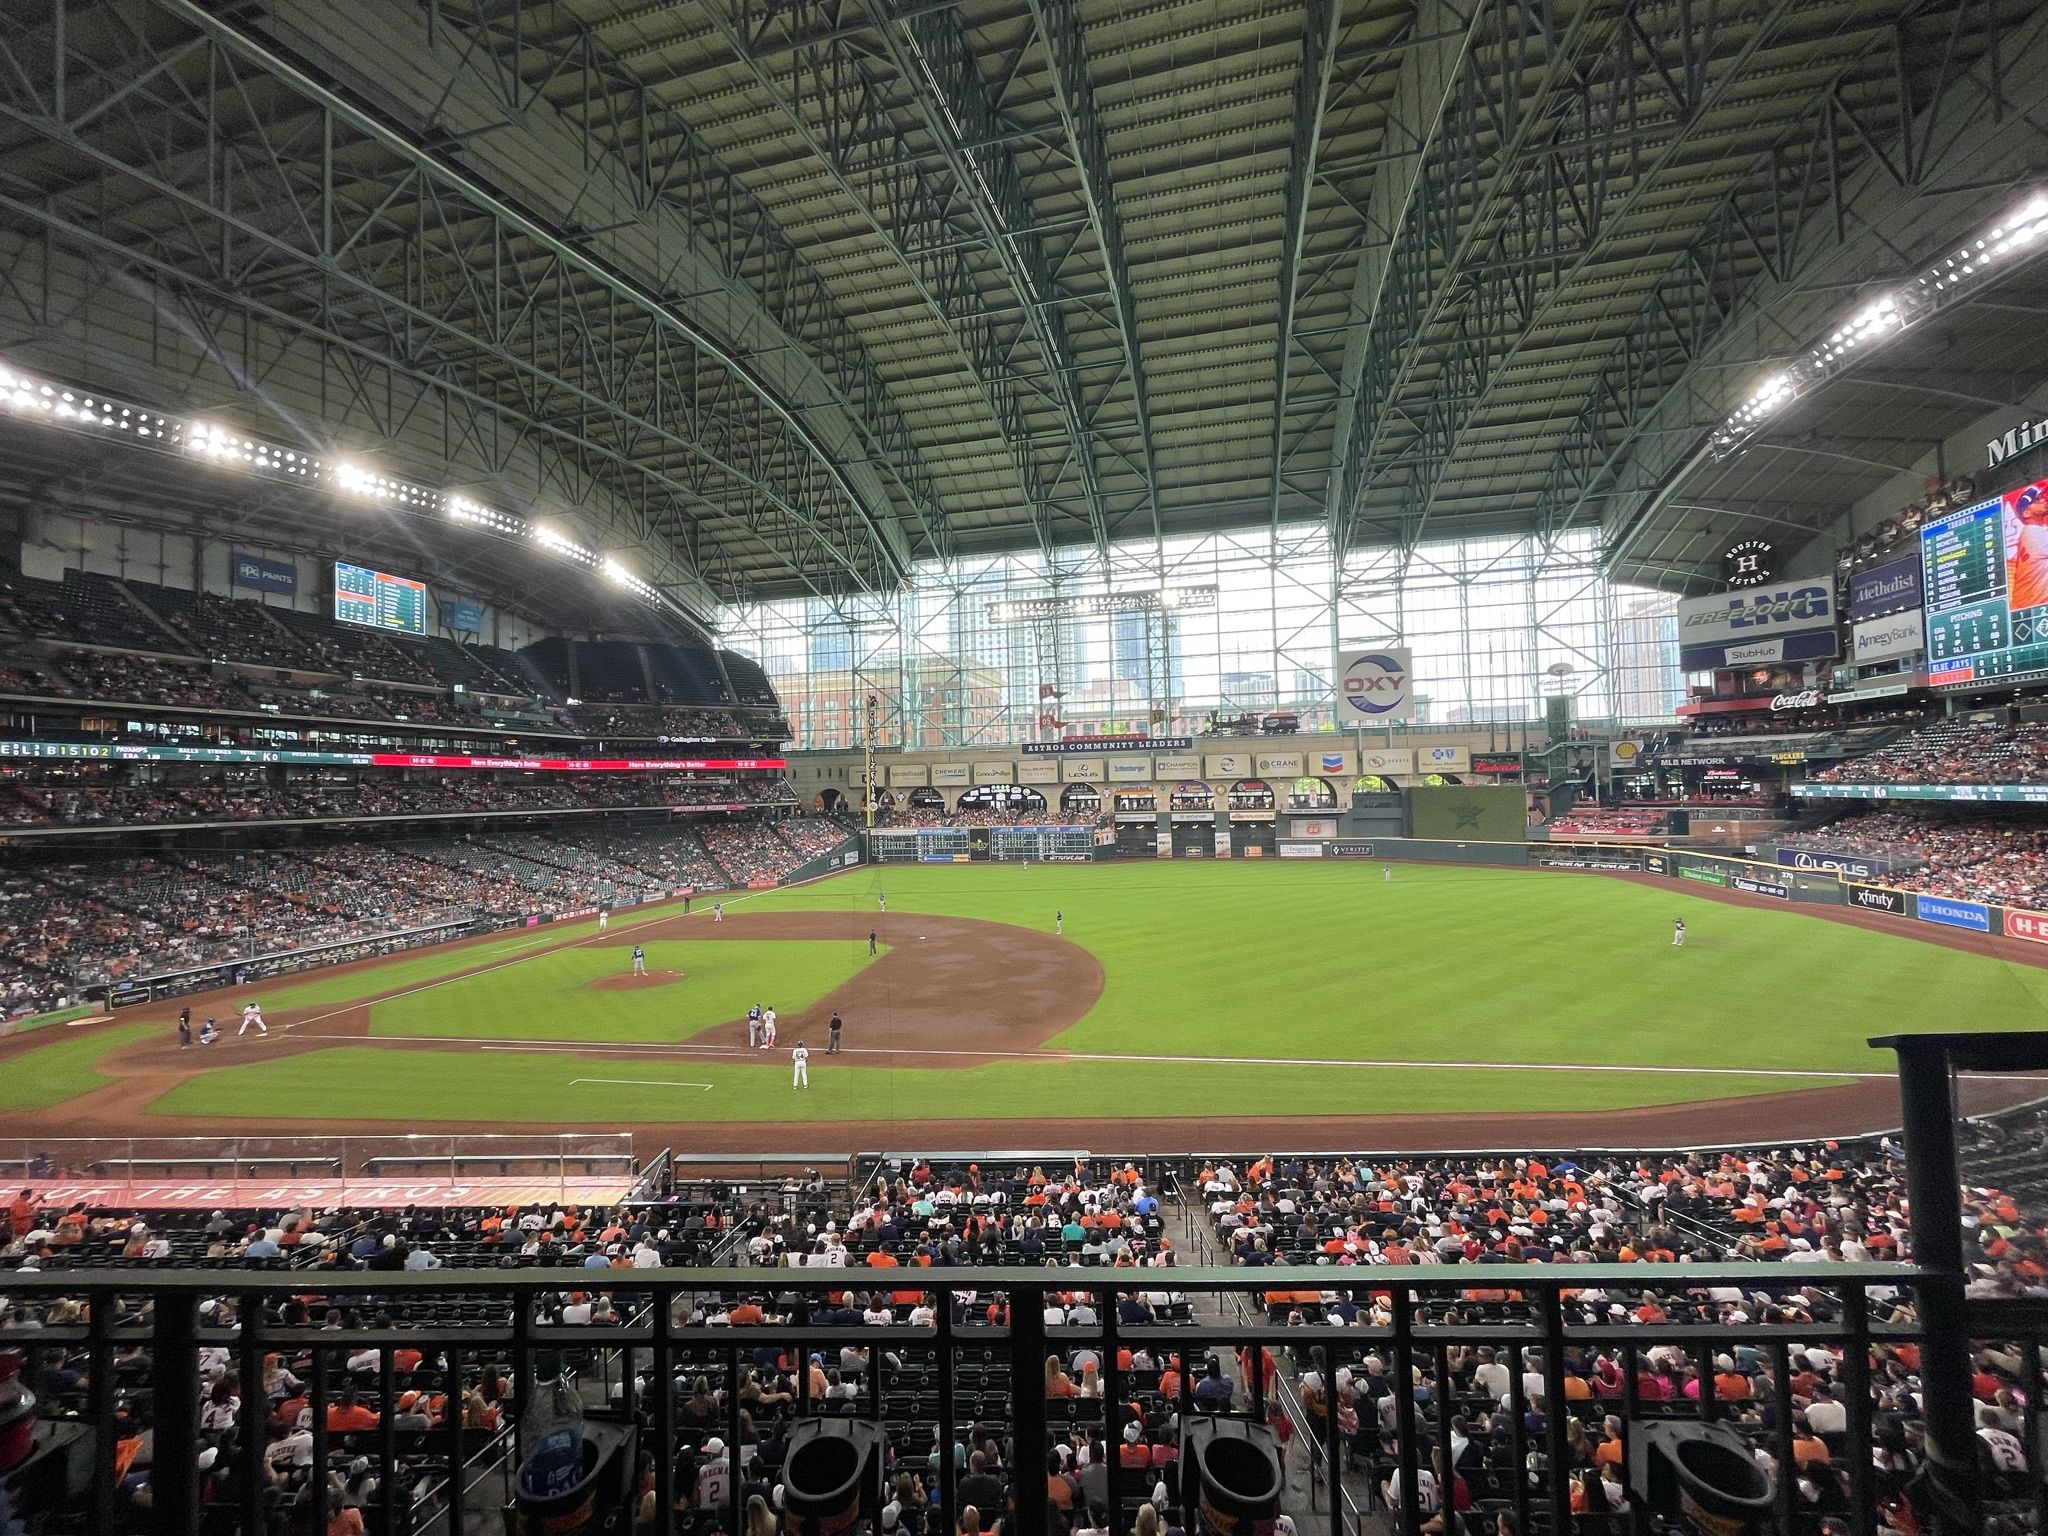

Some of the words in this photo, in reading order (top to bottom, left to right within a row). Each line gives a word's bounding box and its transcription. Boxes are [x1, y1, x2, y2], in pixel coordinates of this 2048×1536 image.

[1726, 541, 1771, 559] HOUSTON
[1737, 554, 1758, 573] H
[263, 571, 293, 584] PAINTS
[1729, 570, 1770, 585] ASTROS
[1856, 574, 1915, 603] Methodist
[1686, 597, 1807, 626] FREEPORT
[1729, 586, 1829, 629] LNG
[1951, 609, 1983, 622] PITCHING
[1859, 625, 1919, 649] AmegyBank
[1732, 647, 1776, 660] StubHub
[1933, 661, 1950, 672] BLUE
[1951, 659, 1970, 670] JAYS
[1344, 676, 1406, 693] OXY
[1042, 718, 1052, 726] 05
[671, 736, 700, 744] Gallagher
[1028, 744, 1065, 752] ASTROS
[1069, 742, 1134, 751] COMMUNITY
[1139, 740, 1187, 748] LEADERS
[23, 745, 31, 755] L
[47, 746, 56, 755] B
[60, 747, 66, 755] 1
[70, 747, 78, 756] S
[82, 747, 87, 756] 1
[102, 747, 109, 757] 2
[263, 753, 271, 762] K
[1772, 753, 1805, 761] PLUCKERS
[487, 760, 523, 769] Everything's
[646, 761, 686, 770] Everything's
[1661, 759, 1679, 767] MLB
[1681, 758, 1726, 766] NETWORK
[1580, 827, 1616, 835] Budweiser
[1811, 859, 1869, 877] LEXUS
[1858, 890, 1894, 910] xfinity
[1932, 906, 1986, 923] HONDA
[44, 1186, 124, 1200] OF
[134, 1185, 236, 1200] THE
[254, 1184, 474, 1200] ASTROS
[831, 1254, 838, 1264] 2
[205, 1410, 217, 1428] 4
[2001, 1449, 2018, 1471] 2
[710, 1481, 720, 1504] 2
